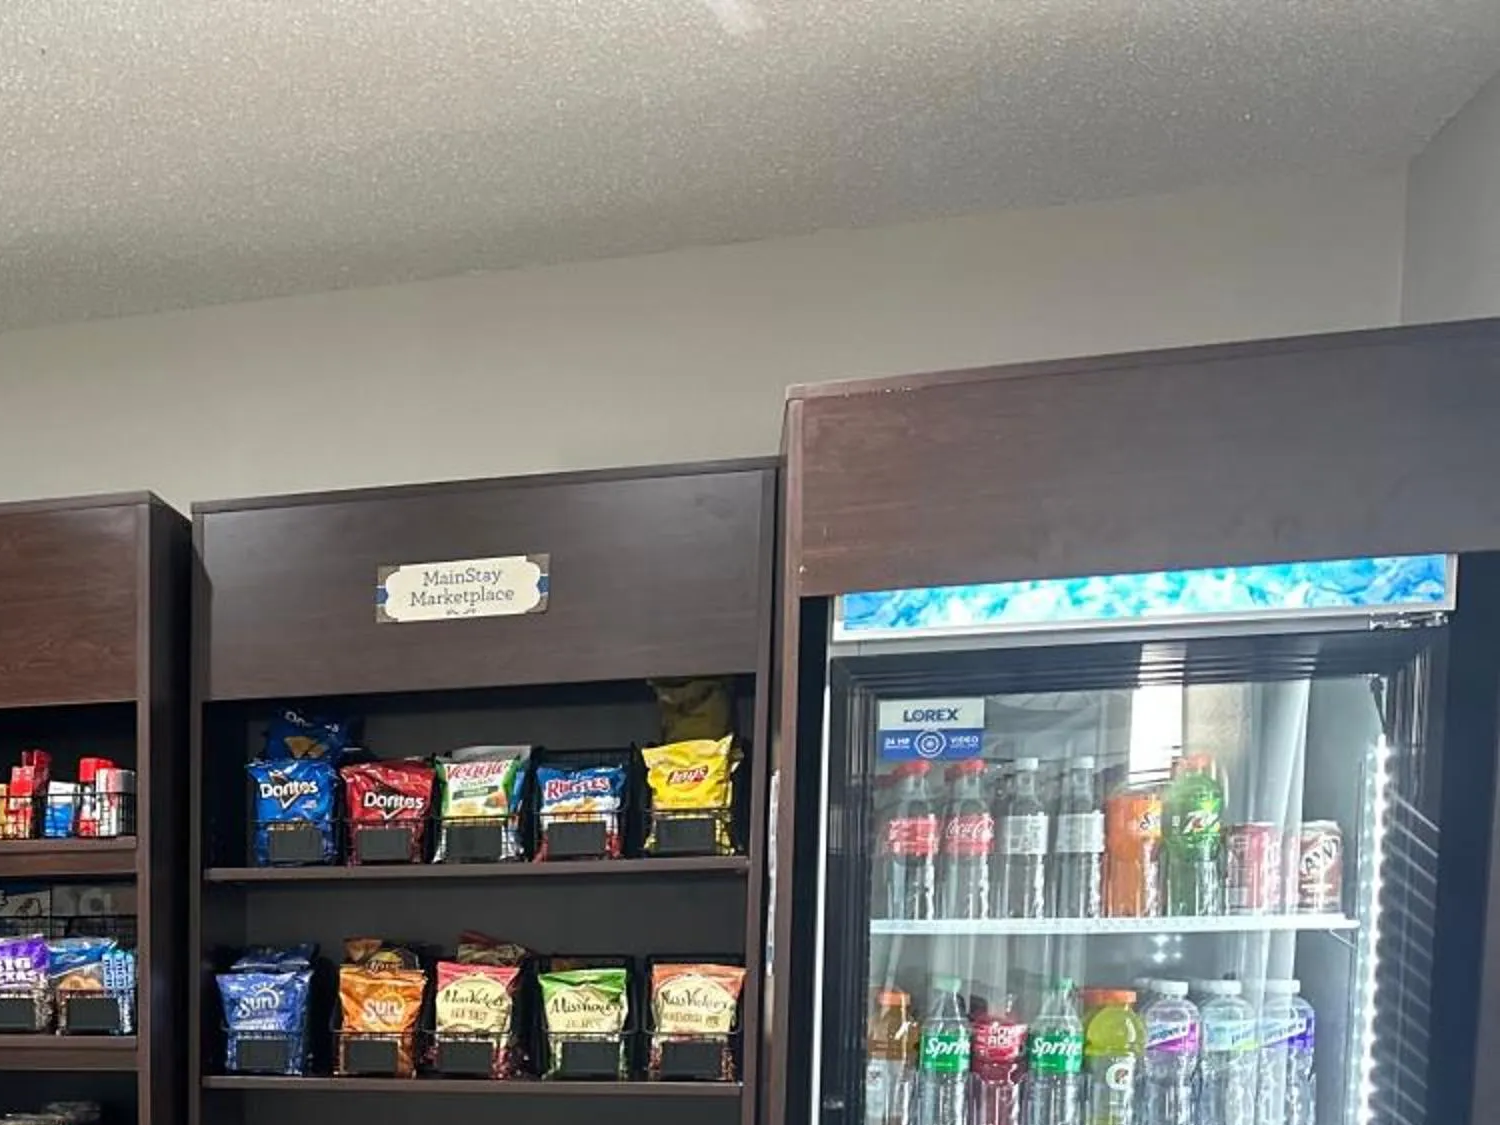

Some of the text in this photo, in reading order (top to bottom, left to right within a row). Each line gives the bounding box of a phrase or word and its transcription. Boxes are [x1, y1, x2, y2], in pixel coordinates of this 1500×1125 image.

[423, 568, 503, 587] MainStay
[409, 585, 515, 608] Marketplace
[903, 709, 959, 723] LOREX
[260, 781, 319, 800] Doritos
[364, 792, 425, 810] Doritos
